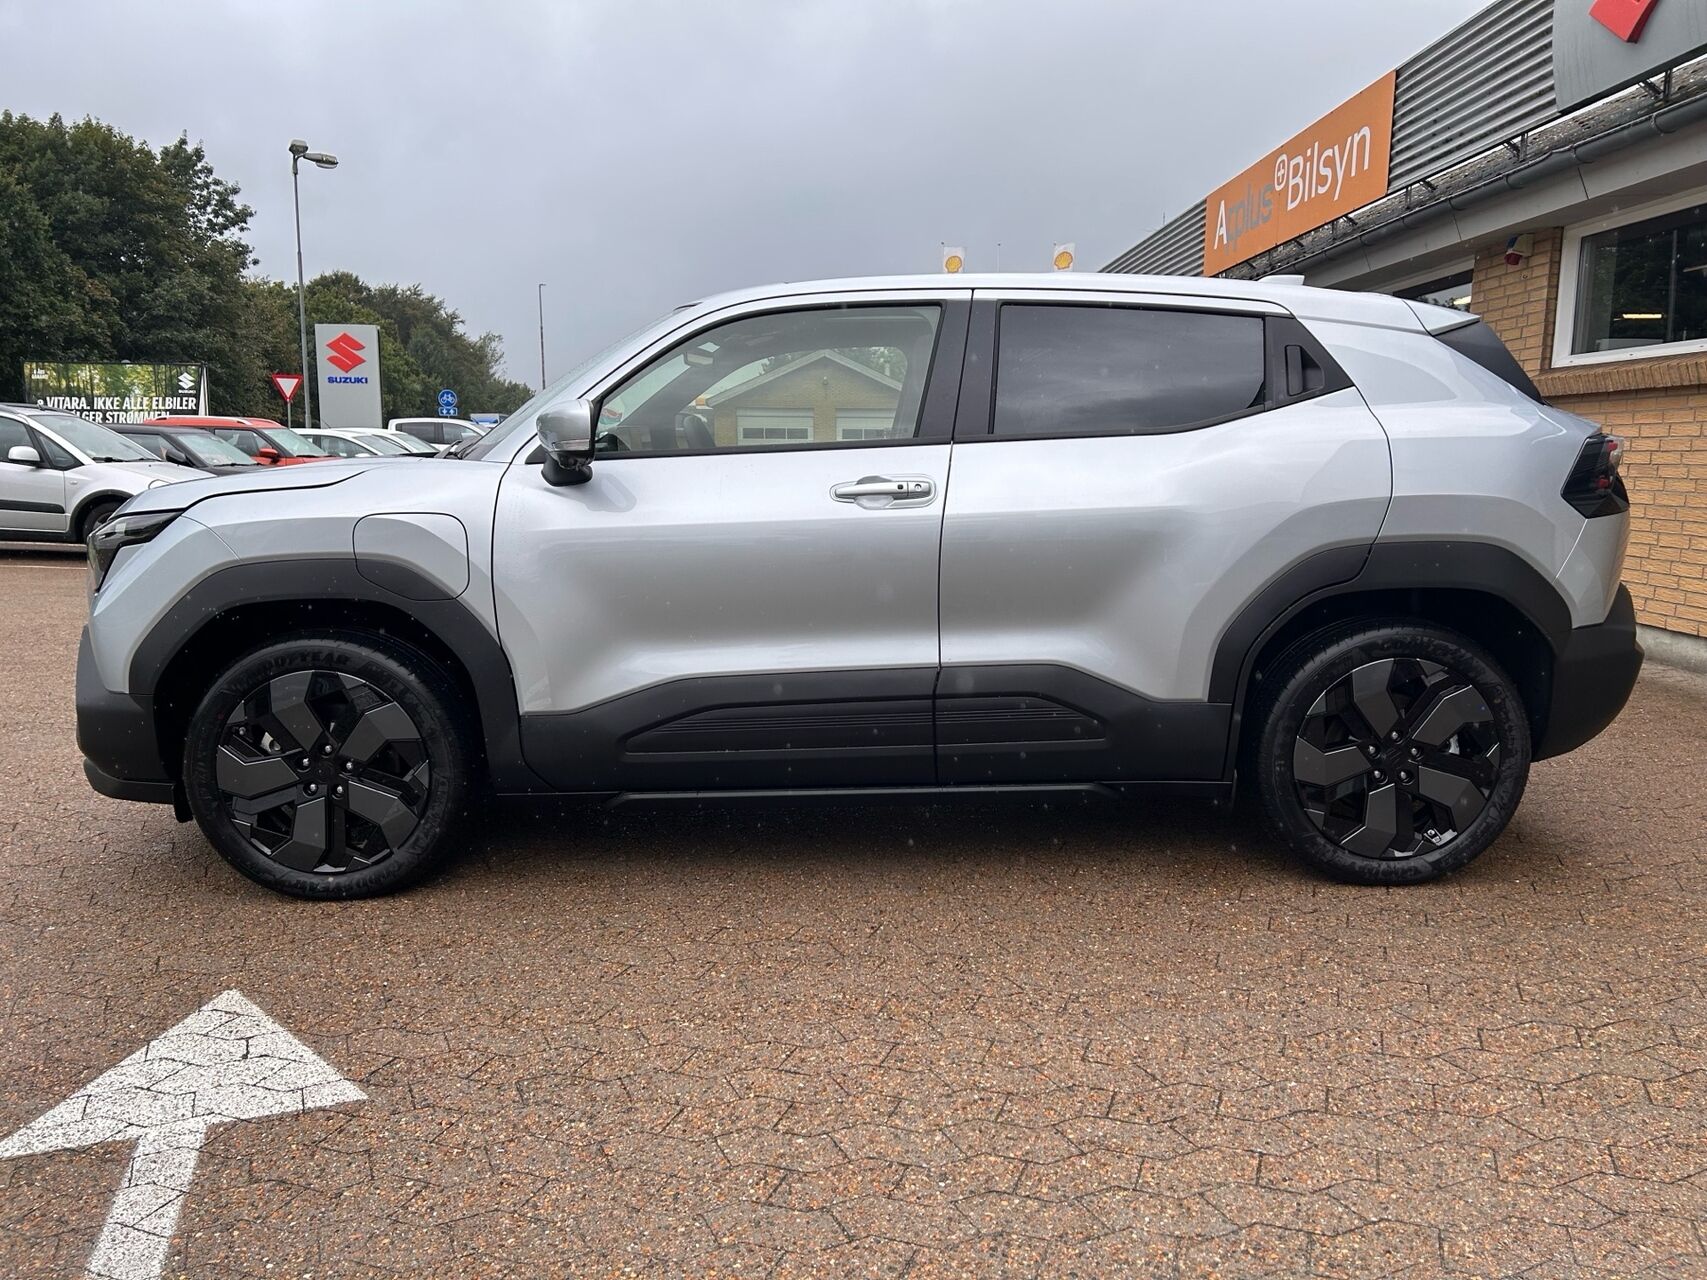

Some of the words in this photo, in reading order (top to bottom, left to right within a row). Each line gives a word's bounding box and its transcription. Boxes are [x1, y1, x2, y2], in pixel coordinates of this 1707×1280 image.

[1287, 125, 1371, 212] Bilsyn
[327, 376, 369, 384] SUZUKI
[46, 396, 91, 410] VITARA.
[93, 396, 121, 410] IKKE
[122, 396, 151, 410] ALLE
[152, 396, 197, 410] ELBILER
